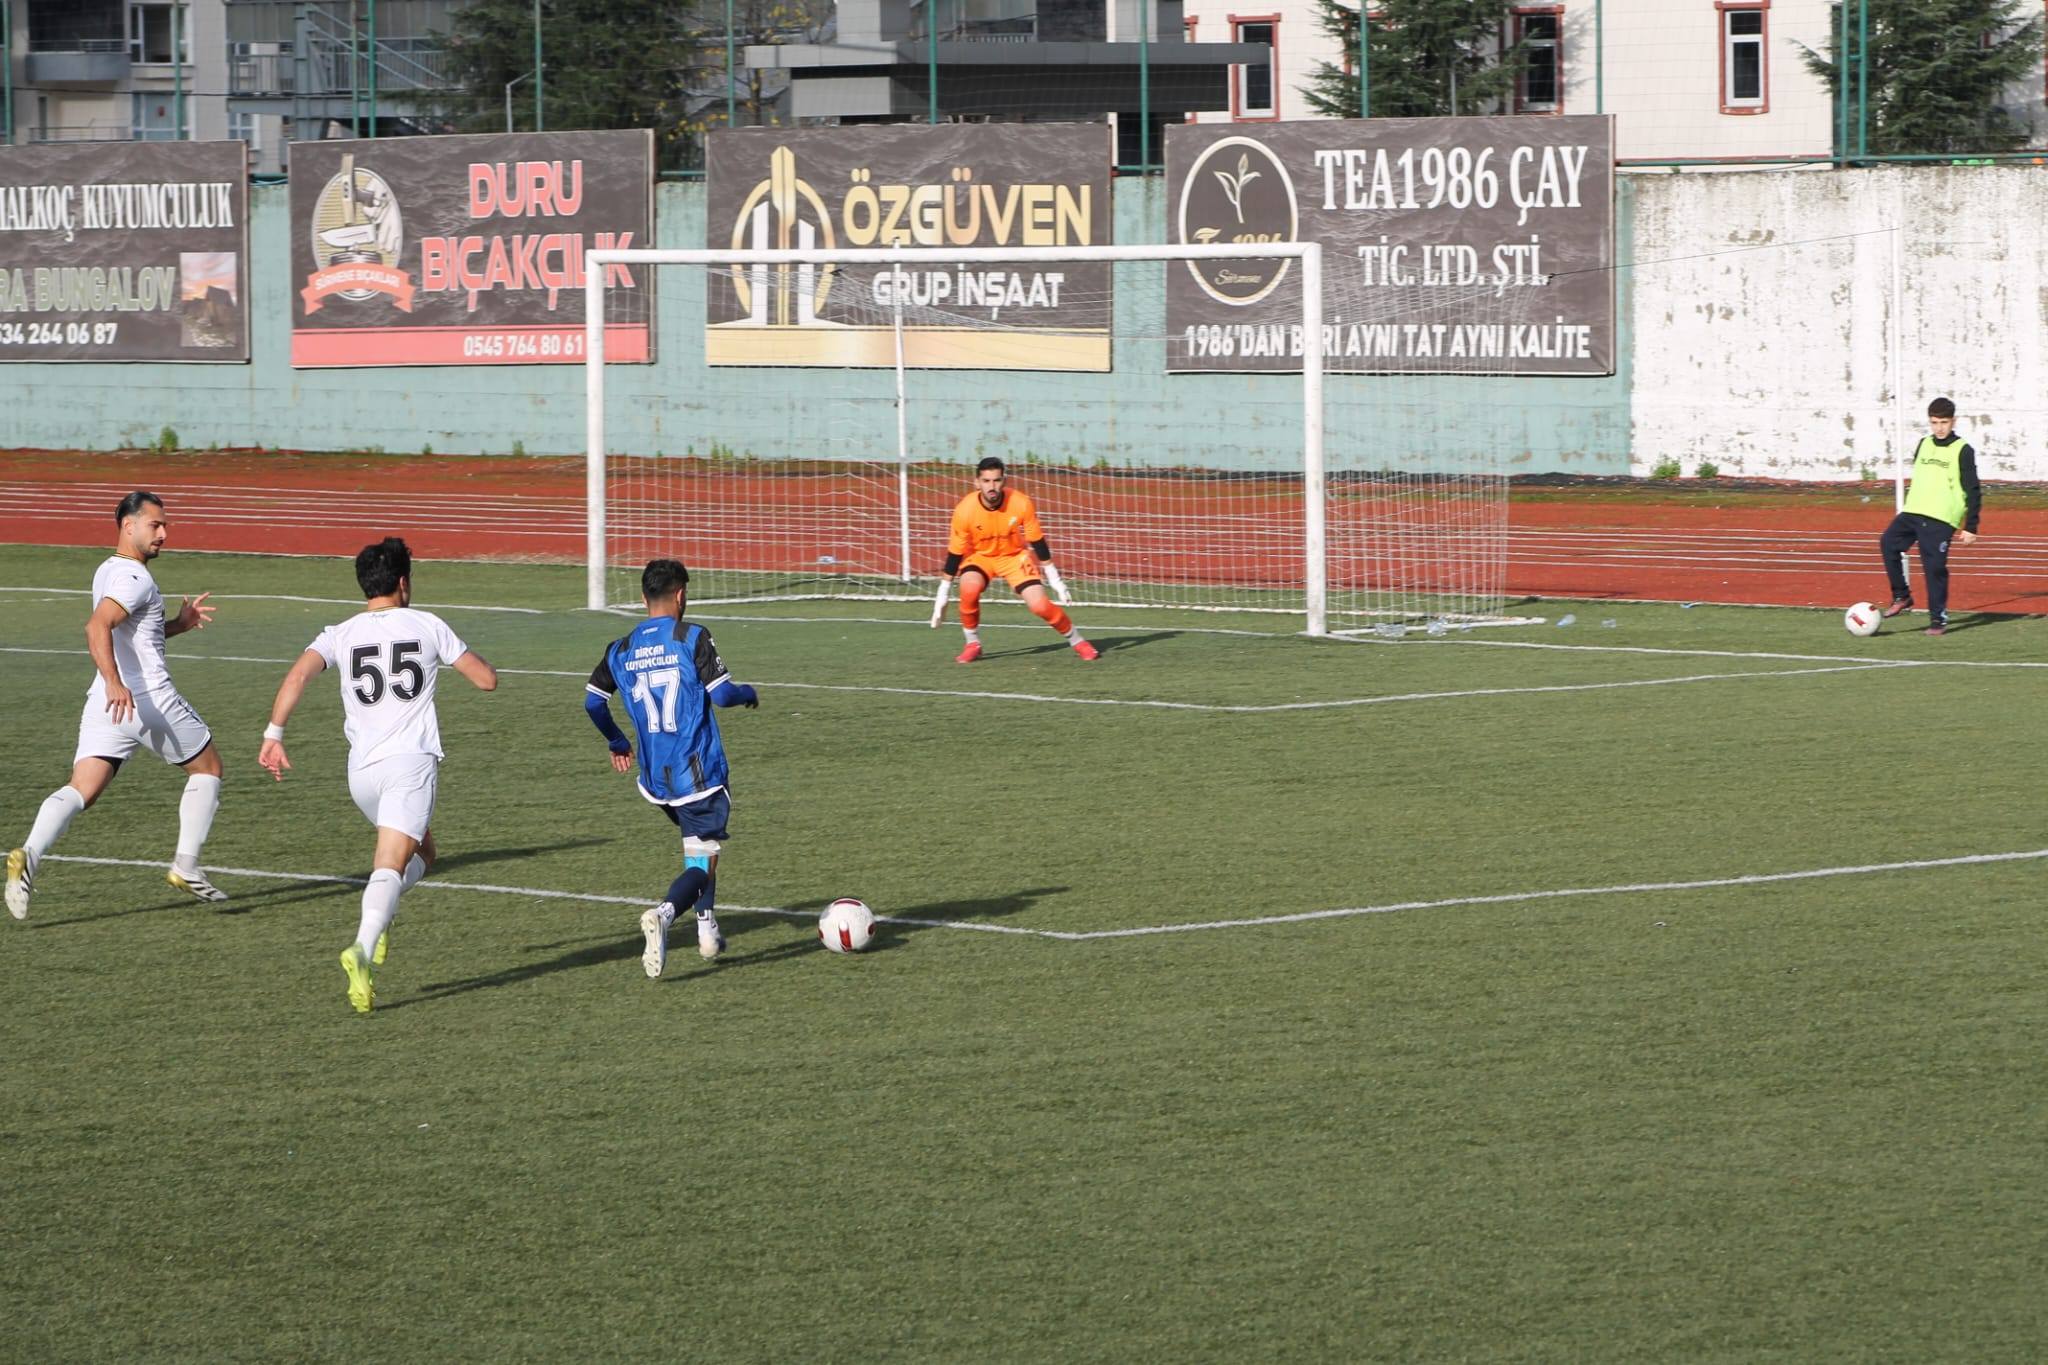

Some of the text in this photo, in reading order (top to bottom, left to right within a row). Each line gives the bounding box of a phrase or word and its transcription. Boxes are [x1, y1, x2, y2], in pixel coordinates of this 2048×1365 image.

[82, 182, 234, 229] KUYUMCULUK
[469, 160, 583, 219] DURU
[843, 167, 1092, 246] ÖZGÜVEN
[1314, 146, 1588, 226] TEA1986 ÇAY
[1358, 235, 1416, 286] TİC.
[1422, 245, 1485, 286] LTD.
[34, 266, 176, 312] BUNGALOV
[872, 263, 1065, 320] GRUP İNŞAAT
[0, 322, 119, 345] 34 264 06 87
[463, 334, 584, 357] 0545 764 80 61
[1184, 315, 1592, 358] 1986'DAN BRİ AYNI TAT AYNI KALİTE
[351, 638, 427, 708] 55
[631, 666, 682, 734] 17
